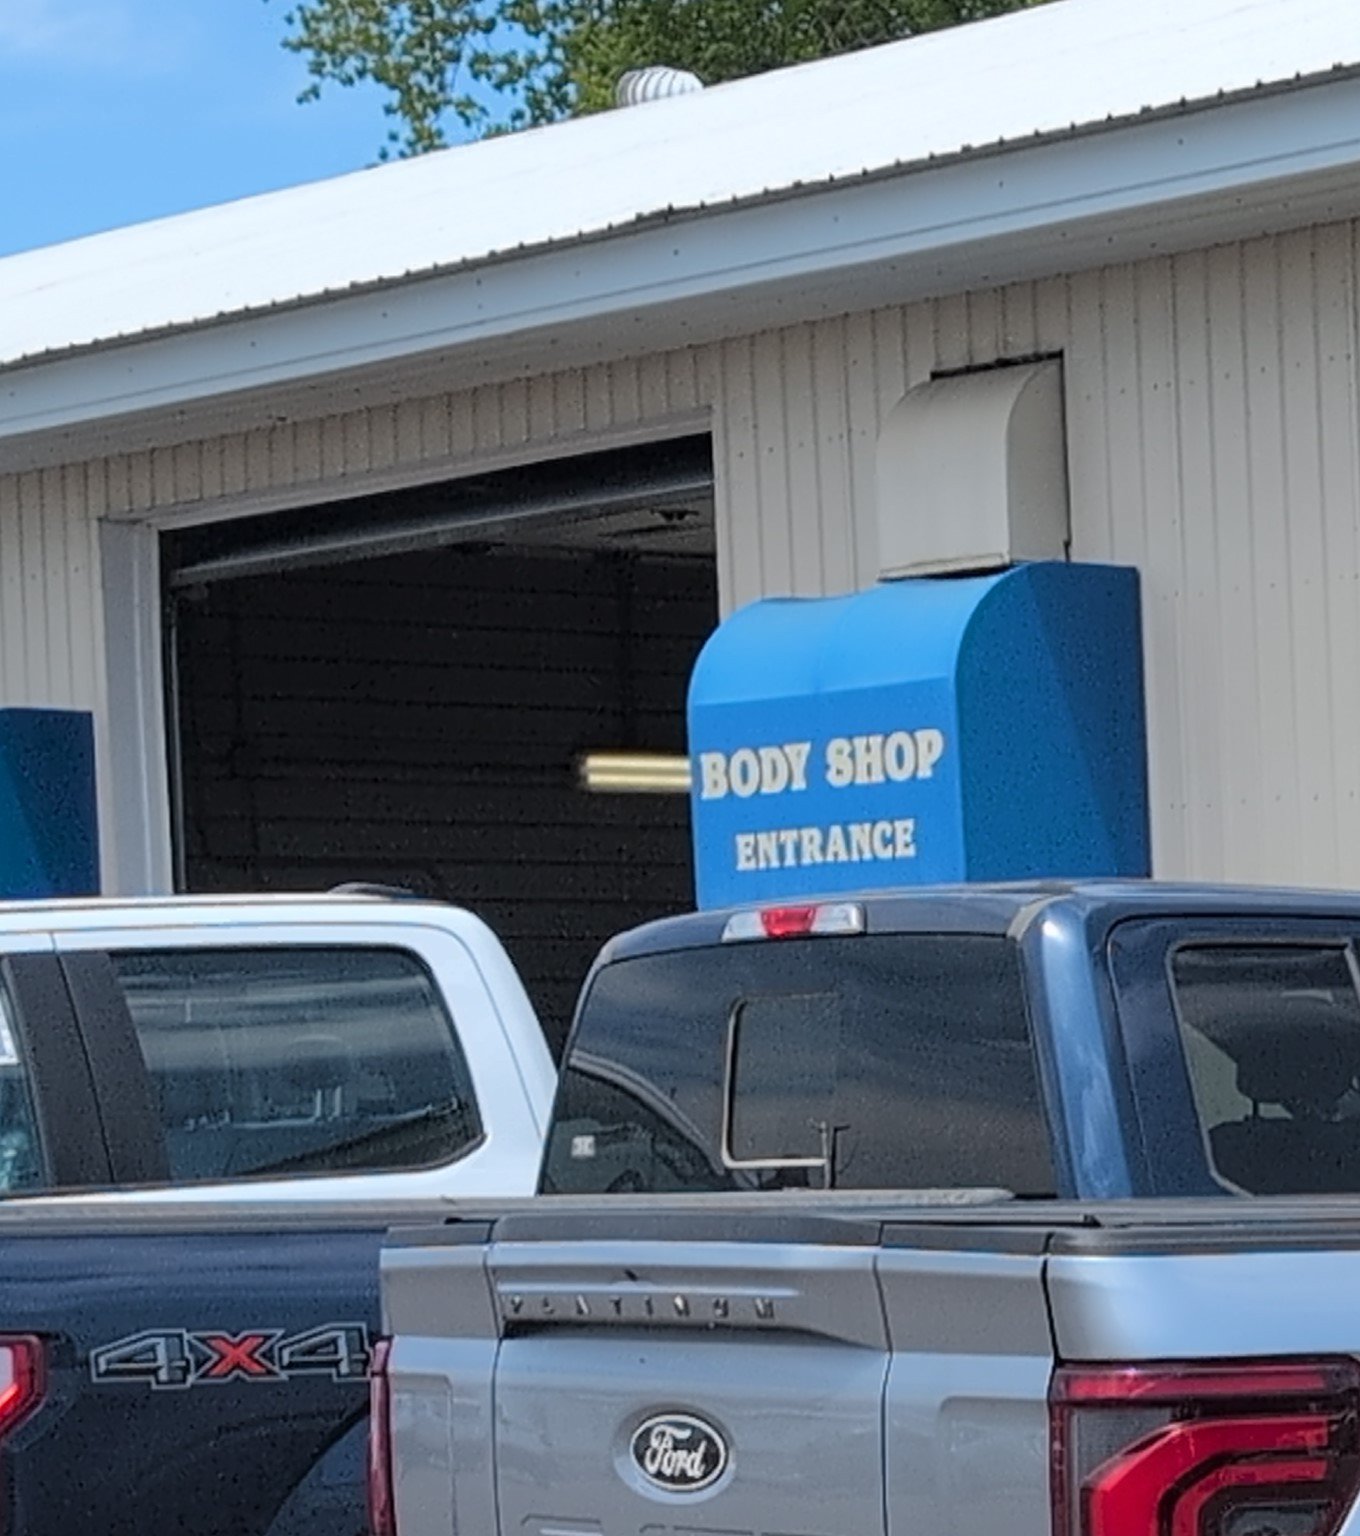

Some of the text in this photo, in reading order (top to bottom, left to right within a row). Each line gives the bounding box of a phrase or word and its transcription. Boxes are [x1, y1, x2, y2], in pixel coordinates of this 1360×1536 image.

[700, 728, 944, 799] BODY SHOP
[735, 818, 916, 871] ENTRANCE
